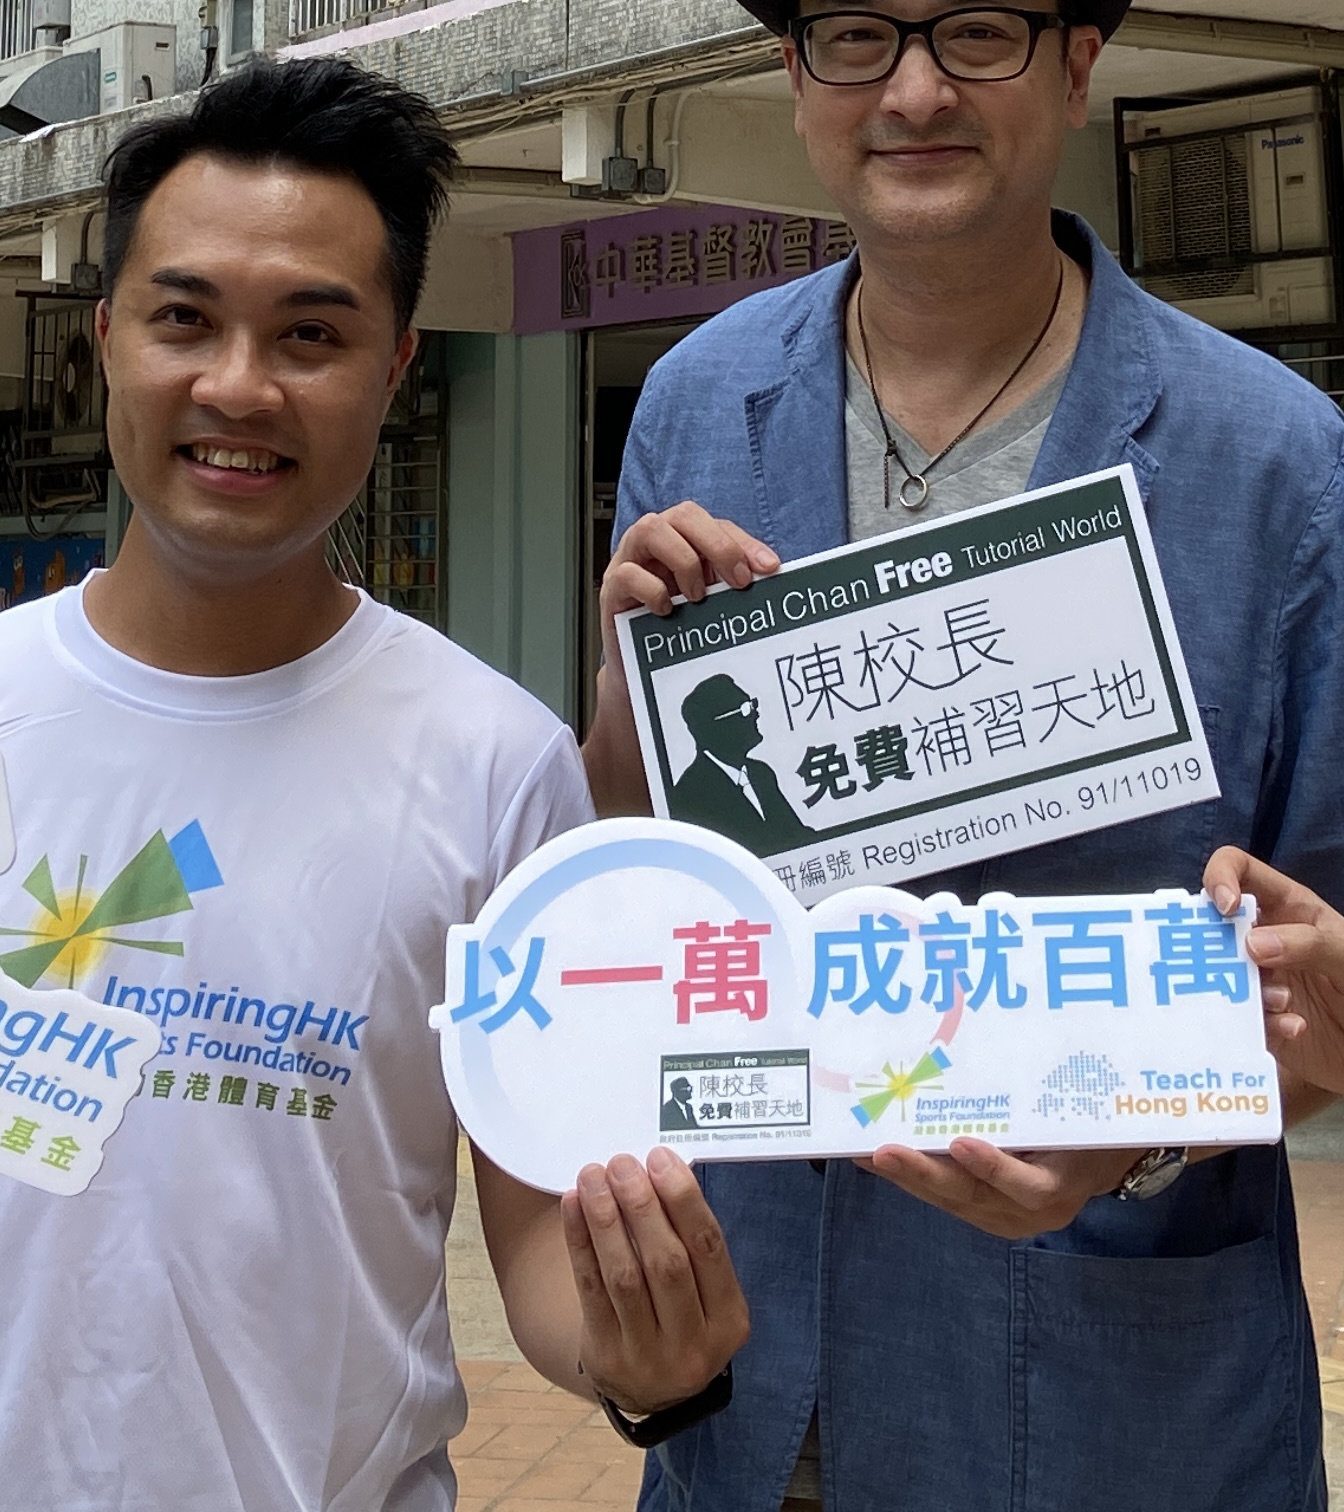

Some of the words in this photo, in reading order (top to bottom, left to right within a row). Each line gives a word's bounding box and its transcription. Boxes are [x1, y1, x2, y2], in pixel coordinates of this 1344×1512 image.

[643, 600, 776, 663] Principal
[782, 577, 869, 622] Chan
[874, 550, 953, 594] Free
[962, 531, 1045, 569] Tutorial
[1051, 505, 1122, 542] World
[775, 598, 1014, 731] 陳校長
[795, 659, 1156, 809] 免費補習天地
[862, 810, 1016, 870] Registration
[1025, 791, 1071, 822] No.
[1078, 758, 1203, 810] 91/11019
[451, 918, 773, 1034] 以一萬
[807, 902, 1252, 1020] 成就百萬
[102, 975, 370, 1051] InspiringHK
[185, 1032, 352, 1086] Foundation
[734, 1056, 758, 1067] Free
[1140, 1068, 1223, 1091] Teach
[1232, 1071, 1266, 1088] For
[135, 1070, 338, 1121] 香港體育基金
[699, 1073, 768, 1098] 陳校長
[699, 1099, 805, 1120] 免費補習天地
[916, 1094, 1010, 1112] InspiringHK
[1115, 1094, 1188, 1117] Hong
[1197, 1092, 1269, 1115] Kong
[915, 1113, 947, 1123] Sports
